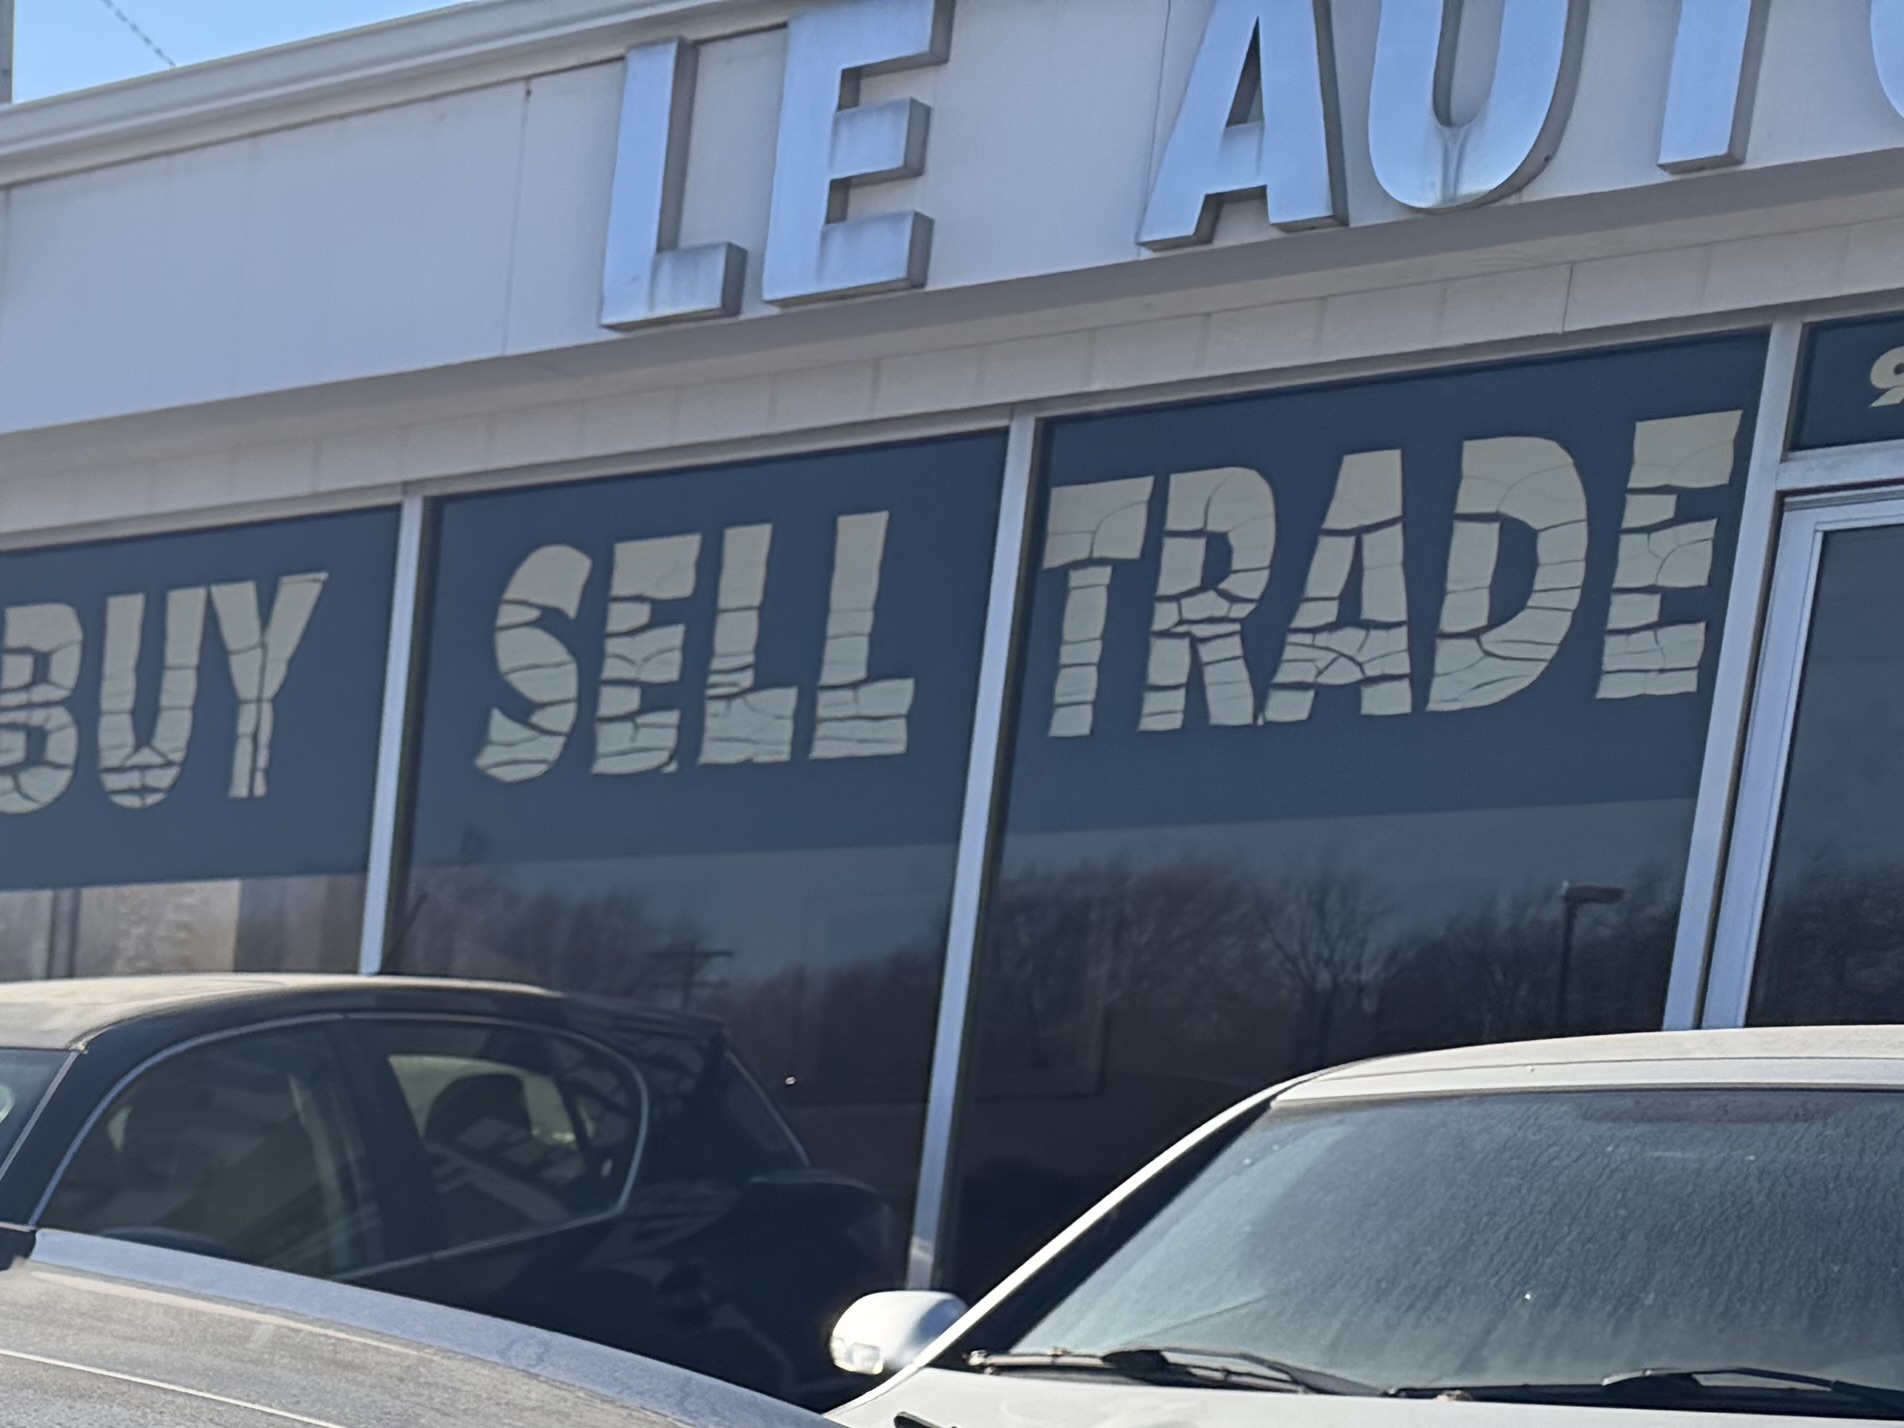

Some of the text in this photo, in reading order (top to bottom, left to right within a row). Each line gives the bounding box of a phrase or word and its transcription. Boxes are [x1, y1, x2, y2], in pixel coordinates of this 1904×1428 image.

[600, 0, 1904, 332] LE AU
[475, 508, 918, 785] SELL
[1041, 409, 1746, 740] TRADE
